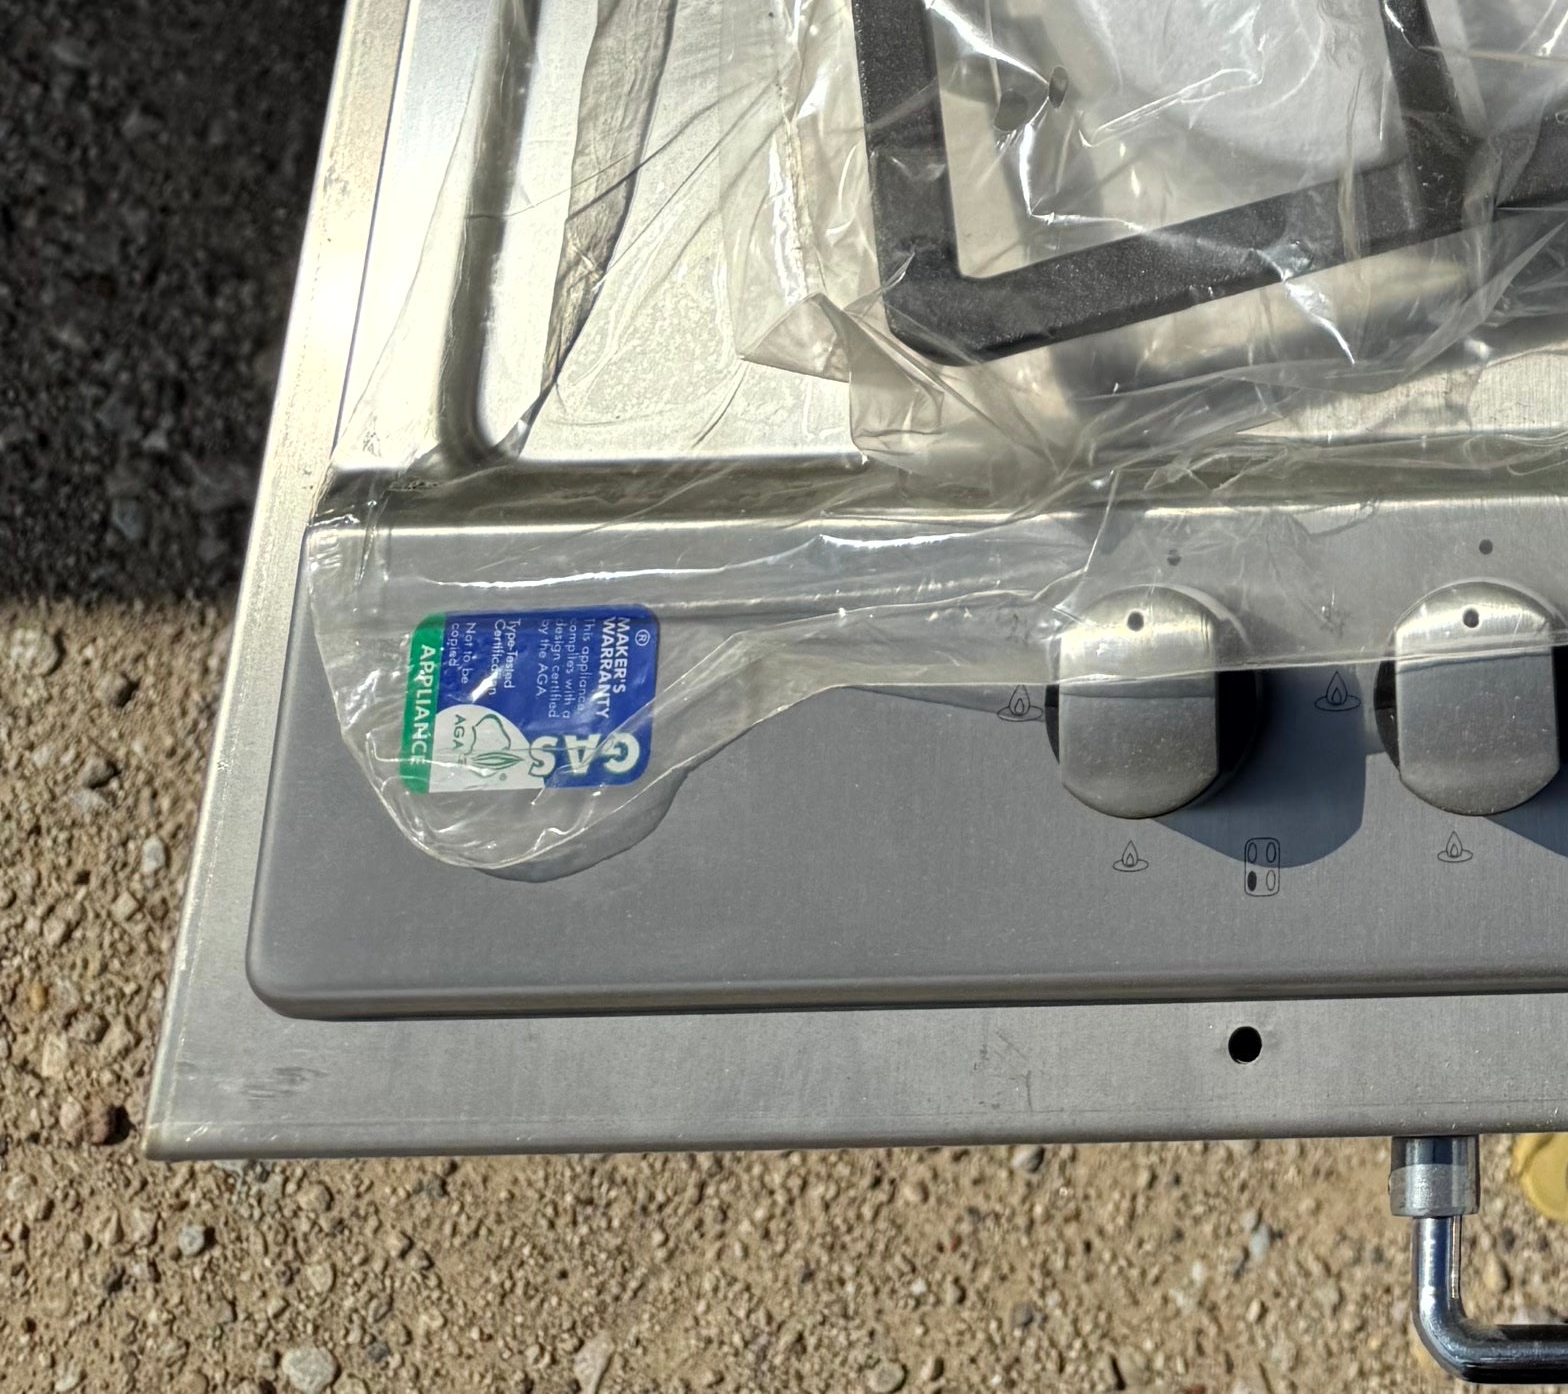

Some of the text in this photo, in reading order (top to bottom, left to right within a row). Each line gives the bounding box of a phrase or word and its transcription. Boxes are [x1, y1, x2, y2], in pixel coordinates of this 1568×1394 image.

[446, 623, 461, 667] copied
[461, 623, 477, 684] Not to be
[504, 619, 521, 688] Type-Tested
[536, 619, 550, 696] by the AGA
[581, 618, 595, 642] This
[613, 617, 631, 693] MAKER'S
[547, 618, 566, 718] design certified
[563, 679, 576, 705] with
[597, 617, 616, 719] WARRANTY
[409, 644, 436, 766] APPLIANCE
[453, 714, 467, 750] AGA
[562, 711, 571, 719] a
[528, 733, 641, 778] GAS
